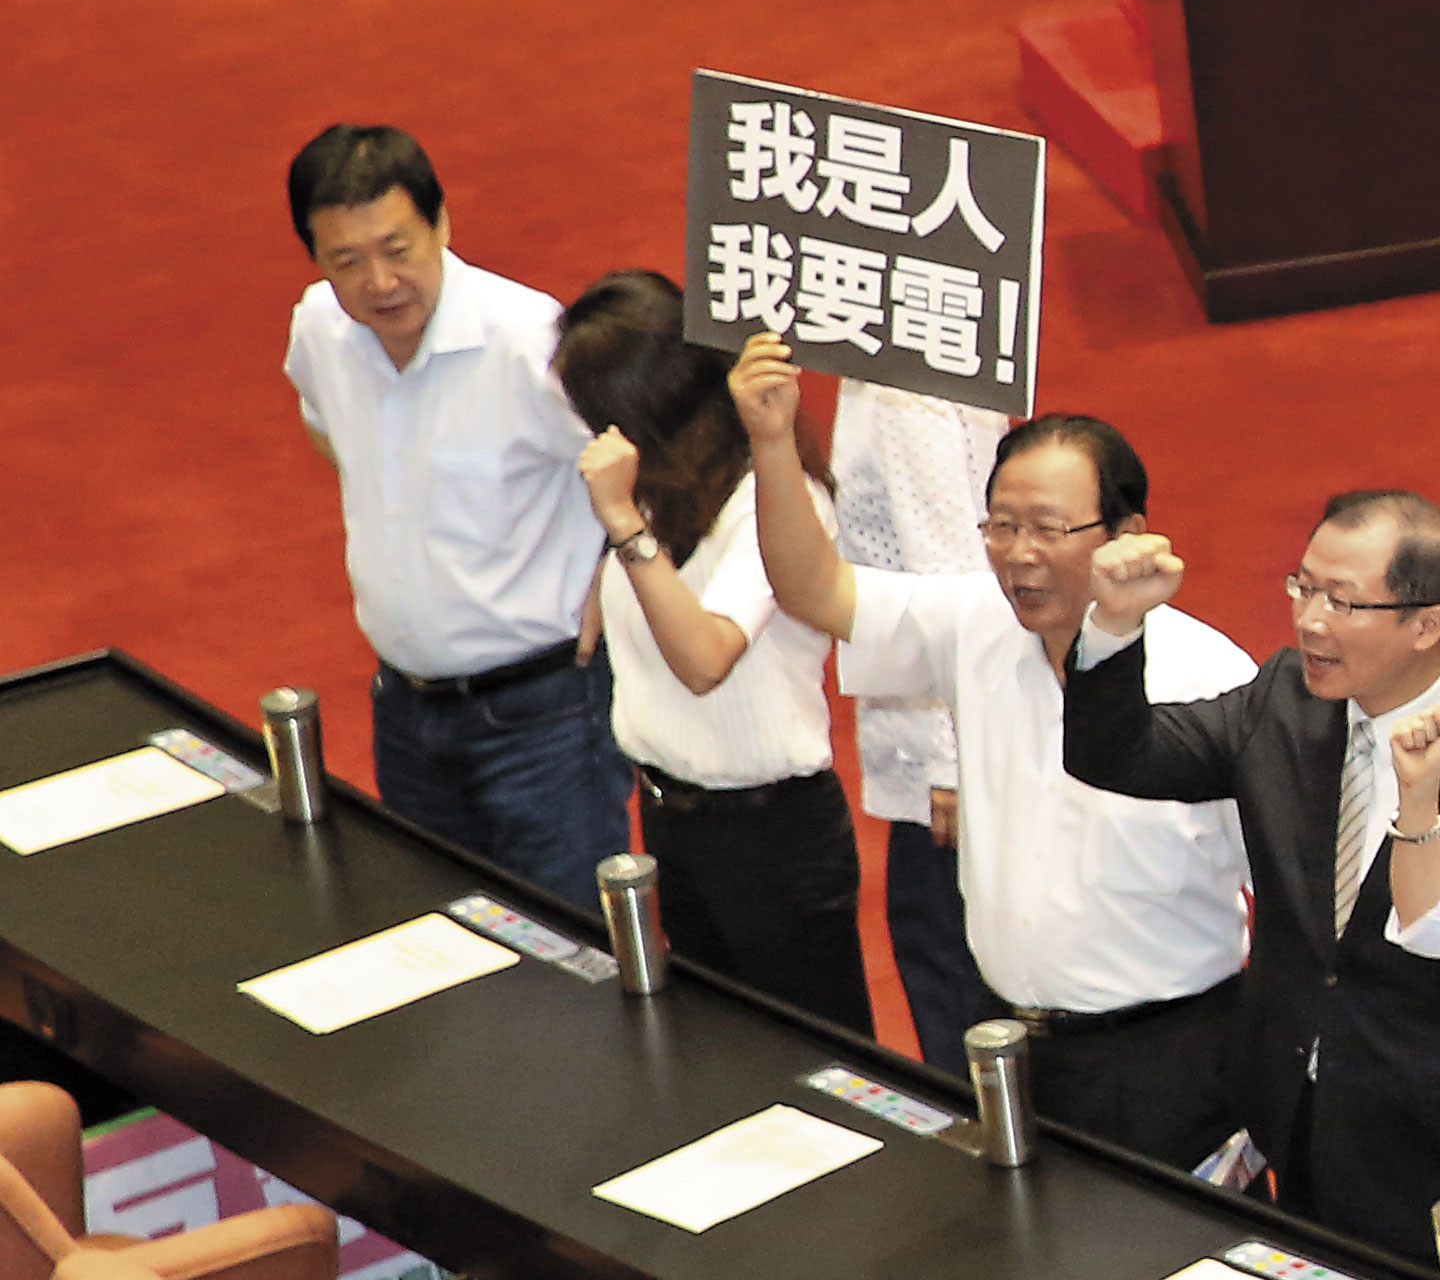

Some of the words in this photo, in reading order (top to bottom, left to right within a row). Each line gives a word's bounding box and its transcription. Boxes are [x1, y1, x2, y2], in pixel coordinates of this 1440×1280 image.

[727, 101, 1005, 253] 我是人
[708, 223, 1019, 385] 我要電!
